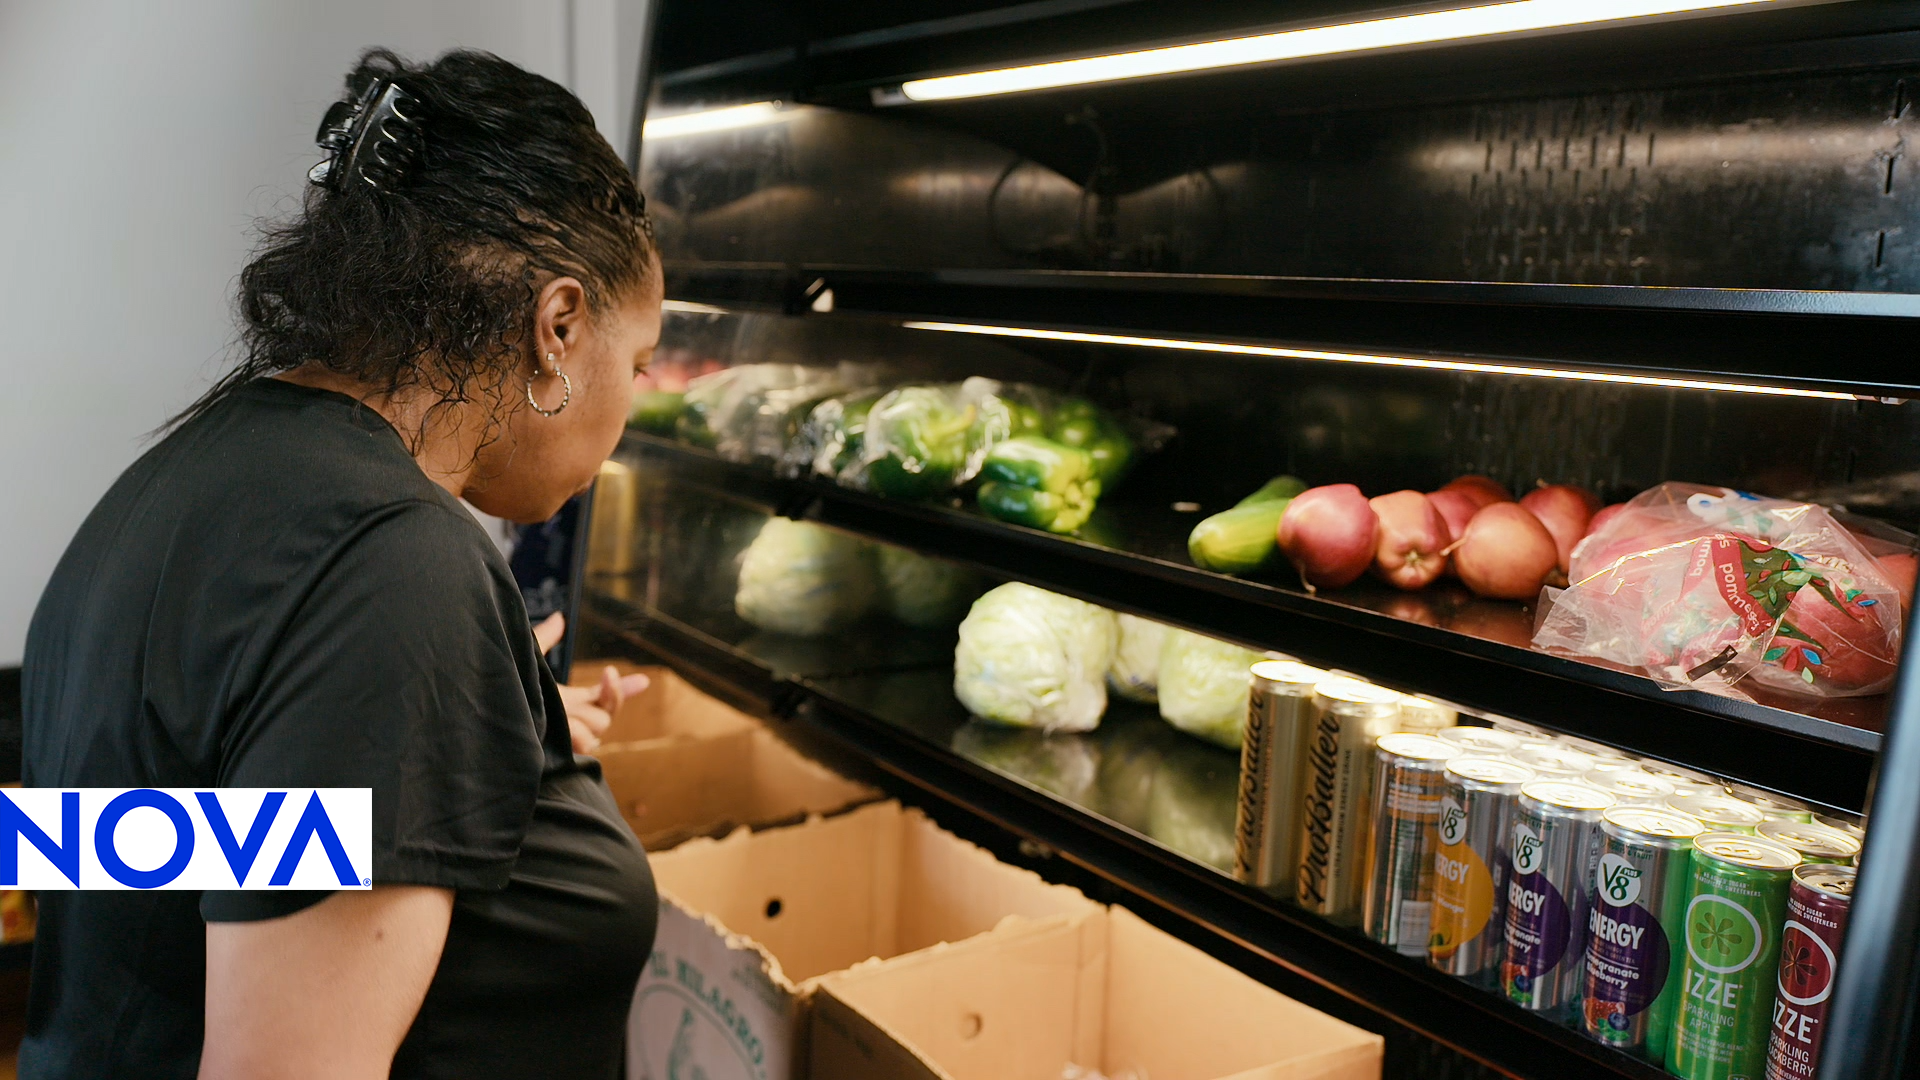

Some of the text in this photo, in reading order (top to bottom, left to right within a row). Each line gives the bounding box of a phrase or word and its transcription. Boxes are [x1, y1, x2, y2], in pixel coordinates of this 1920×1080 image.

[1299, 714, 1340, 904] ProBaller
[1515, 833, 1533, 868] V8
[1603, 862, 1630, 900] V8
[1623, 868, 1638, 877] PLUS
[1725, 886, 1762, 897] SWEETENERS
[1589, 907, 1645, 950] ENERGY
[1803, 912, 1838, 929] SWEETENERS
[1683, 1000, 1735, 1028] SPARKLING
[1689, 1017, 1720, 1037] APPLE
[1770, 1030, 1809, 1063] SPARKLING
